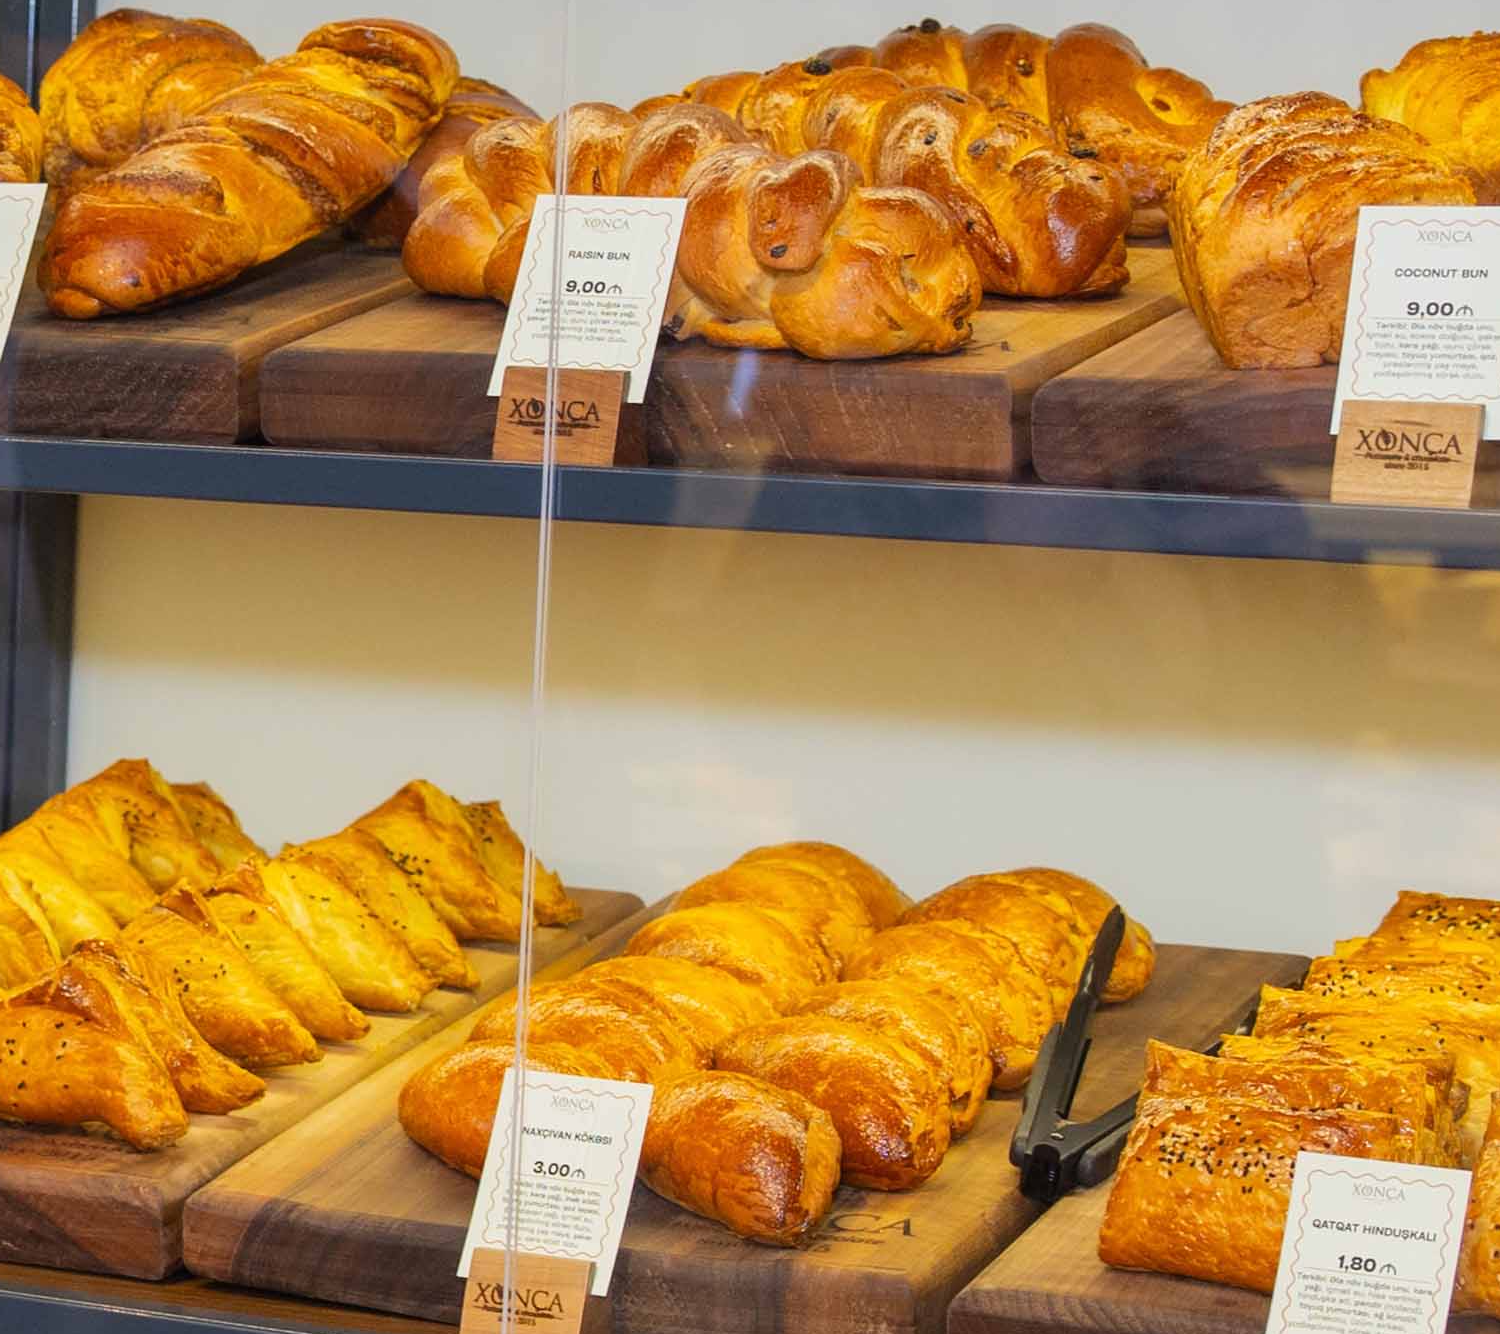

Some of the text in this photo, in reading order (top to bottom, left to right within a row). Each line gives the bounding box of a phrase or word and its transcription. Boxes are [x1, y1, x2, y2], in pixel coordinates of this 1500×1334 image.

[568, 250, 630, 261] RAISIN BUN
[1394, 268, 1489, 279] COCONUT BUN
[565, 280, 606, 295] 9,00
[1407, 302, 1454, 318] 9,00
[522, 1126, 572, 1142] NAXÇIVAN
[533, 1161, 571, 1176] 3,00
[1312, 1219, 1359, 1233] QATQAT
[1337, 1254, 1377, 1273] 1,80
